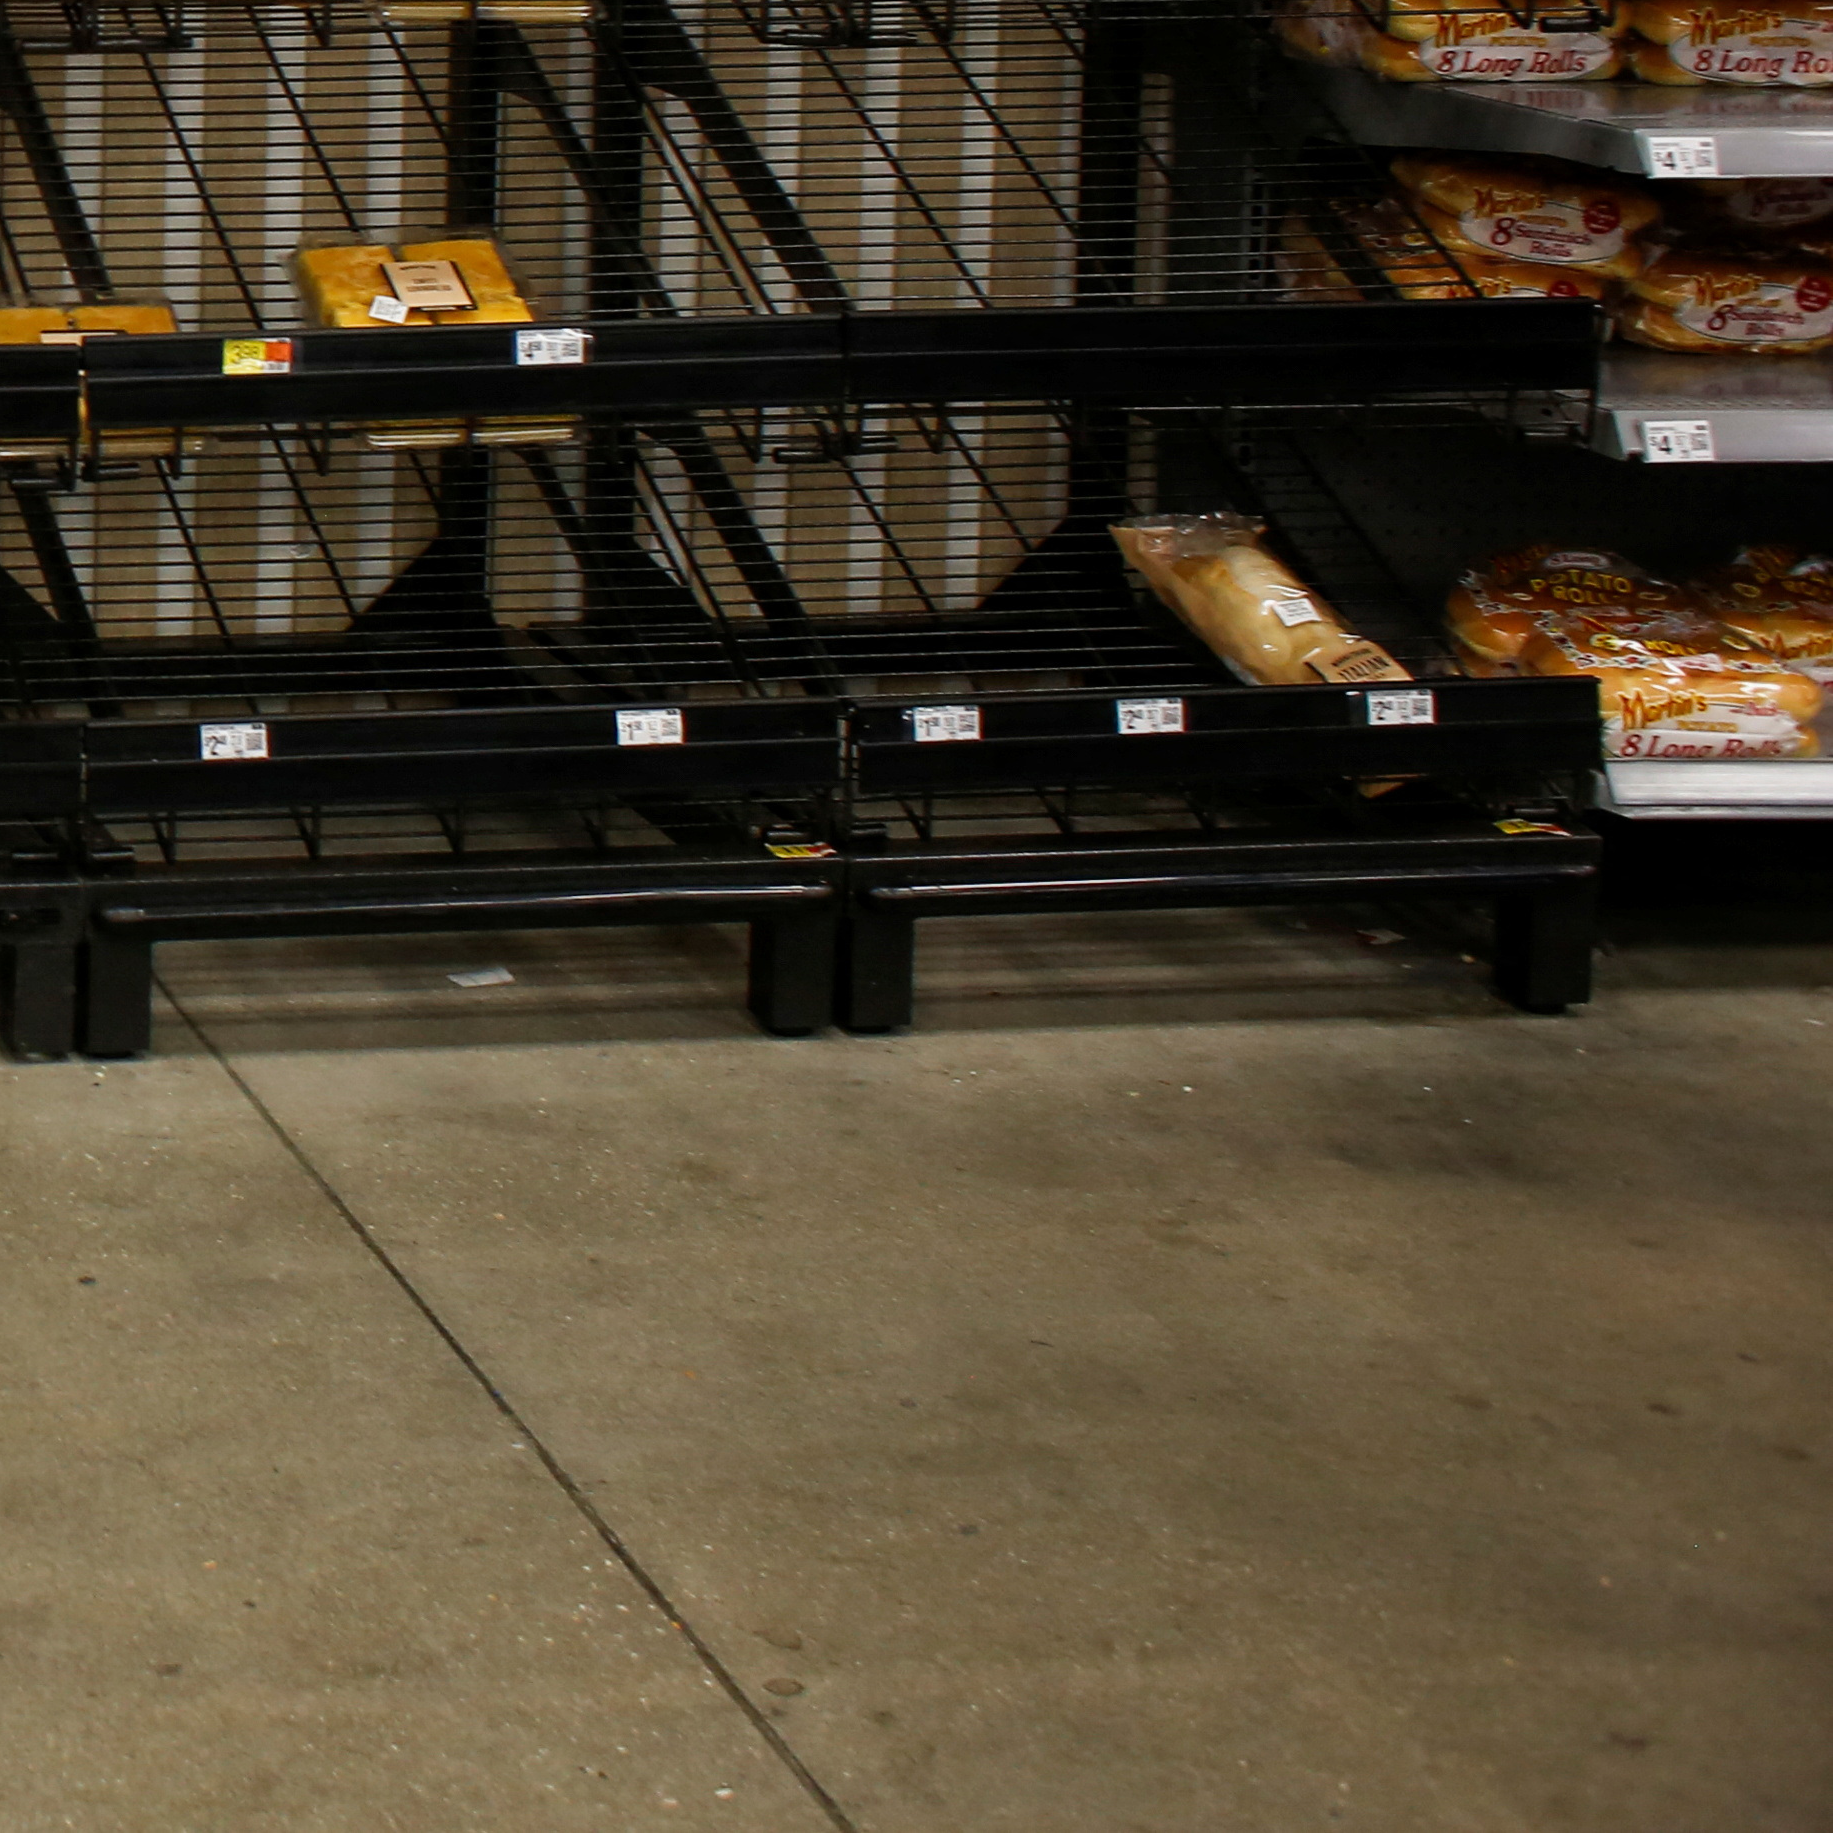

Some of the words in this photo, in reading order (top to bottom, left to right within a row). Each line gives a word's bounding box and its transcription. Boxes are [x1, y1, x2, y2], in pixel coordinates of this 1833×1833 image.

[1436, 50, 1457, 73] 8
[1461, 50, 1522, 77] Long
[1527, 49, 1587, 74] Rolls
[1694, 49, 1714, 73] 8
[1717, 50, 1785, 77] Long
[1791, 50, 1833, 74] Rol
[1491, 217, 1516, 246] 8
[1707, 303, 1734, 332] 8
[1616, 688, 1709, 732] Martin's
[1619, 733, 1643, 759] 8
[1645, 734, 1714, 759] Long
